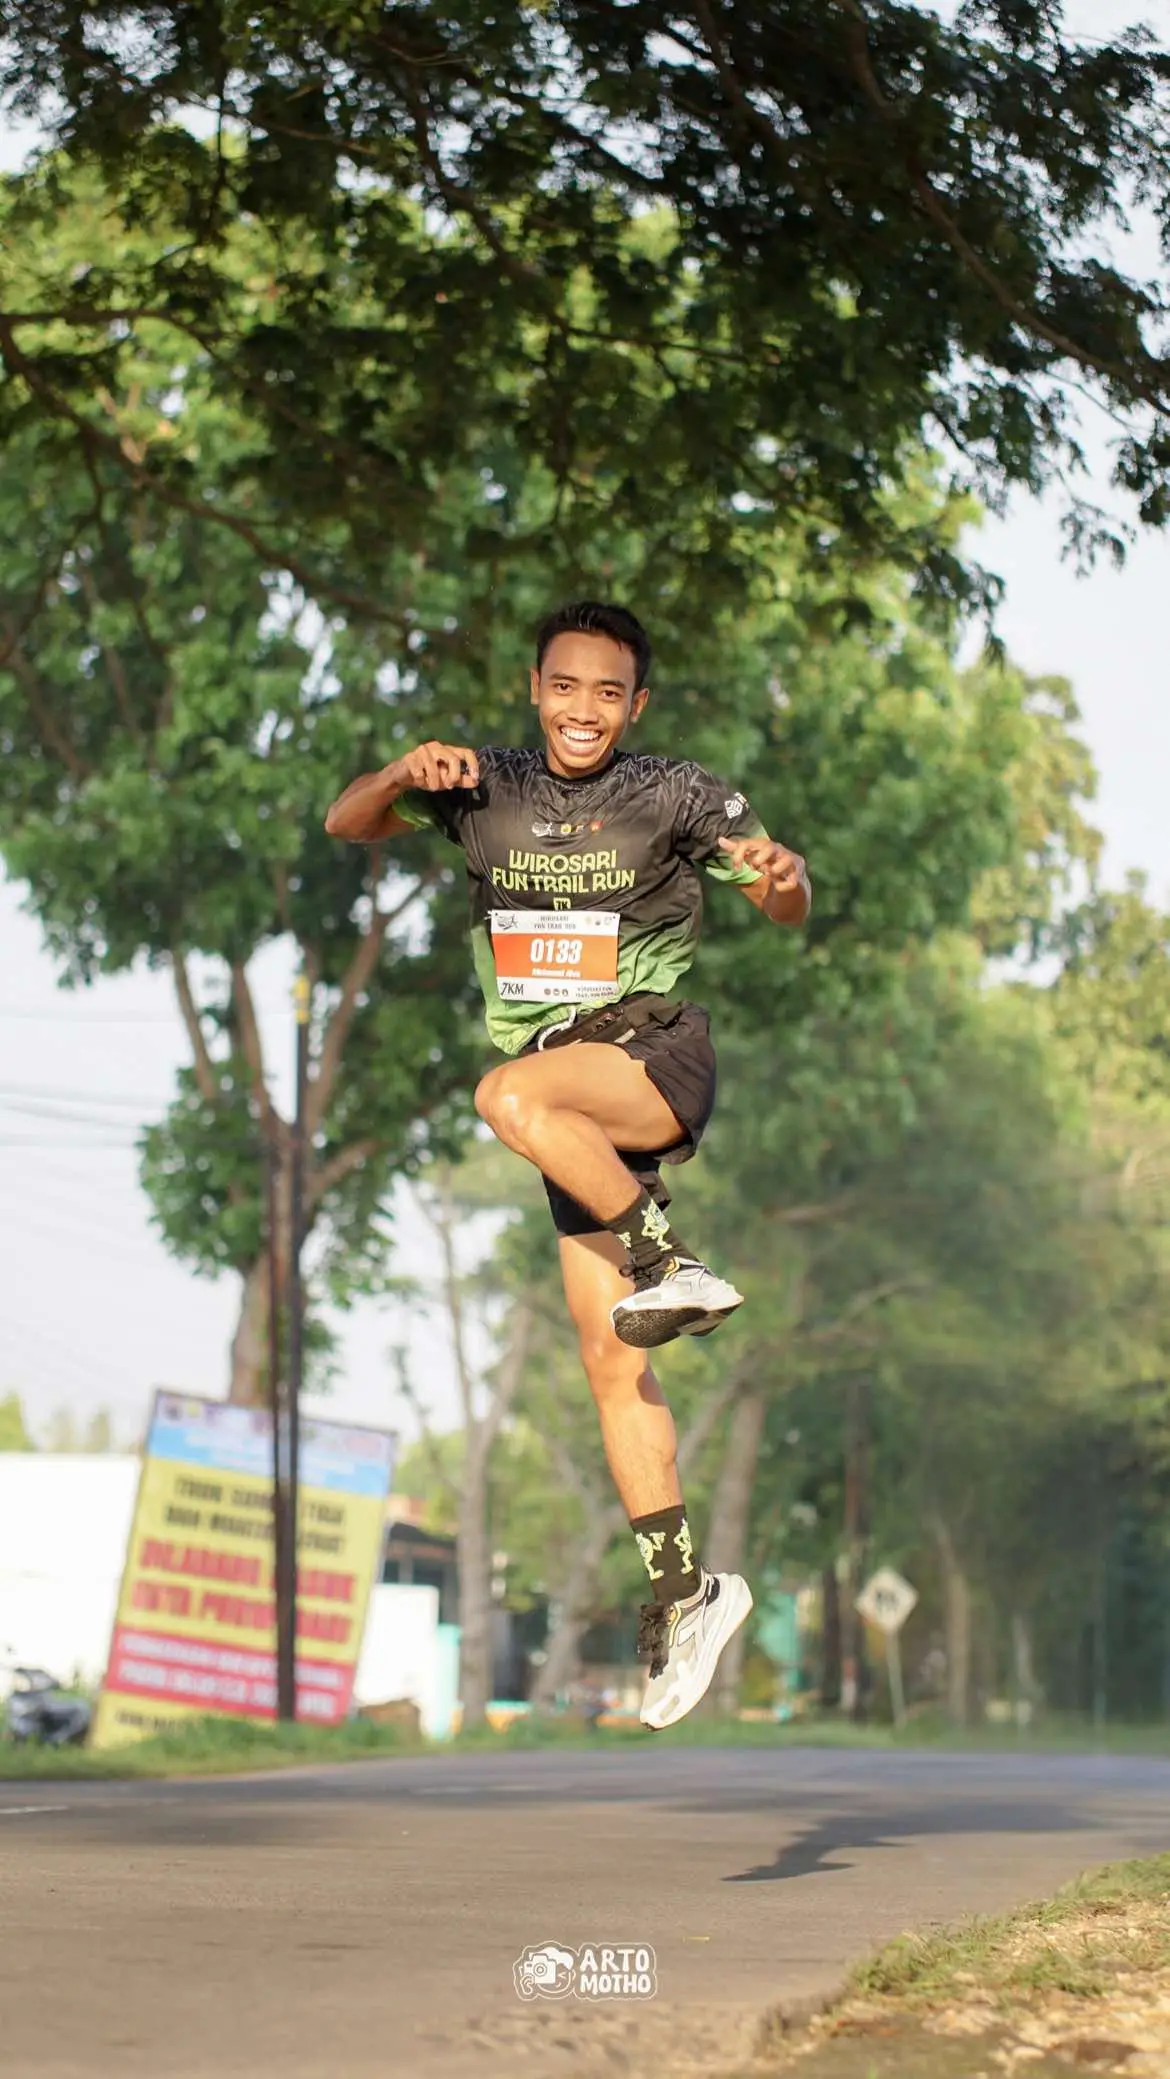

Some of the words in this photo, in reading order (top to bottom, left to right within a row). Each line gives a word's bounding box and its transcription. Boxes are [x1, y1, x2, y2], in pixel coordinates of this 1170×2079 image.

[509, 849, 617, 873] WIROSARI
[492, 866, 529, 891] FUN
[531, 874, 590, 894] TRAIL
[592, 869, 636, 892] RUN
[530, 938, 583, 965] 0133
[500, 982, 524, 996] 7KM
